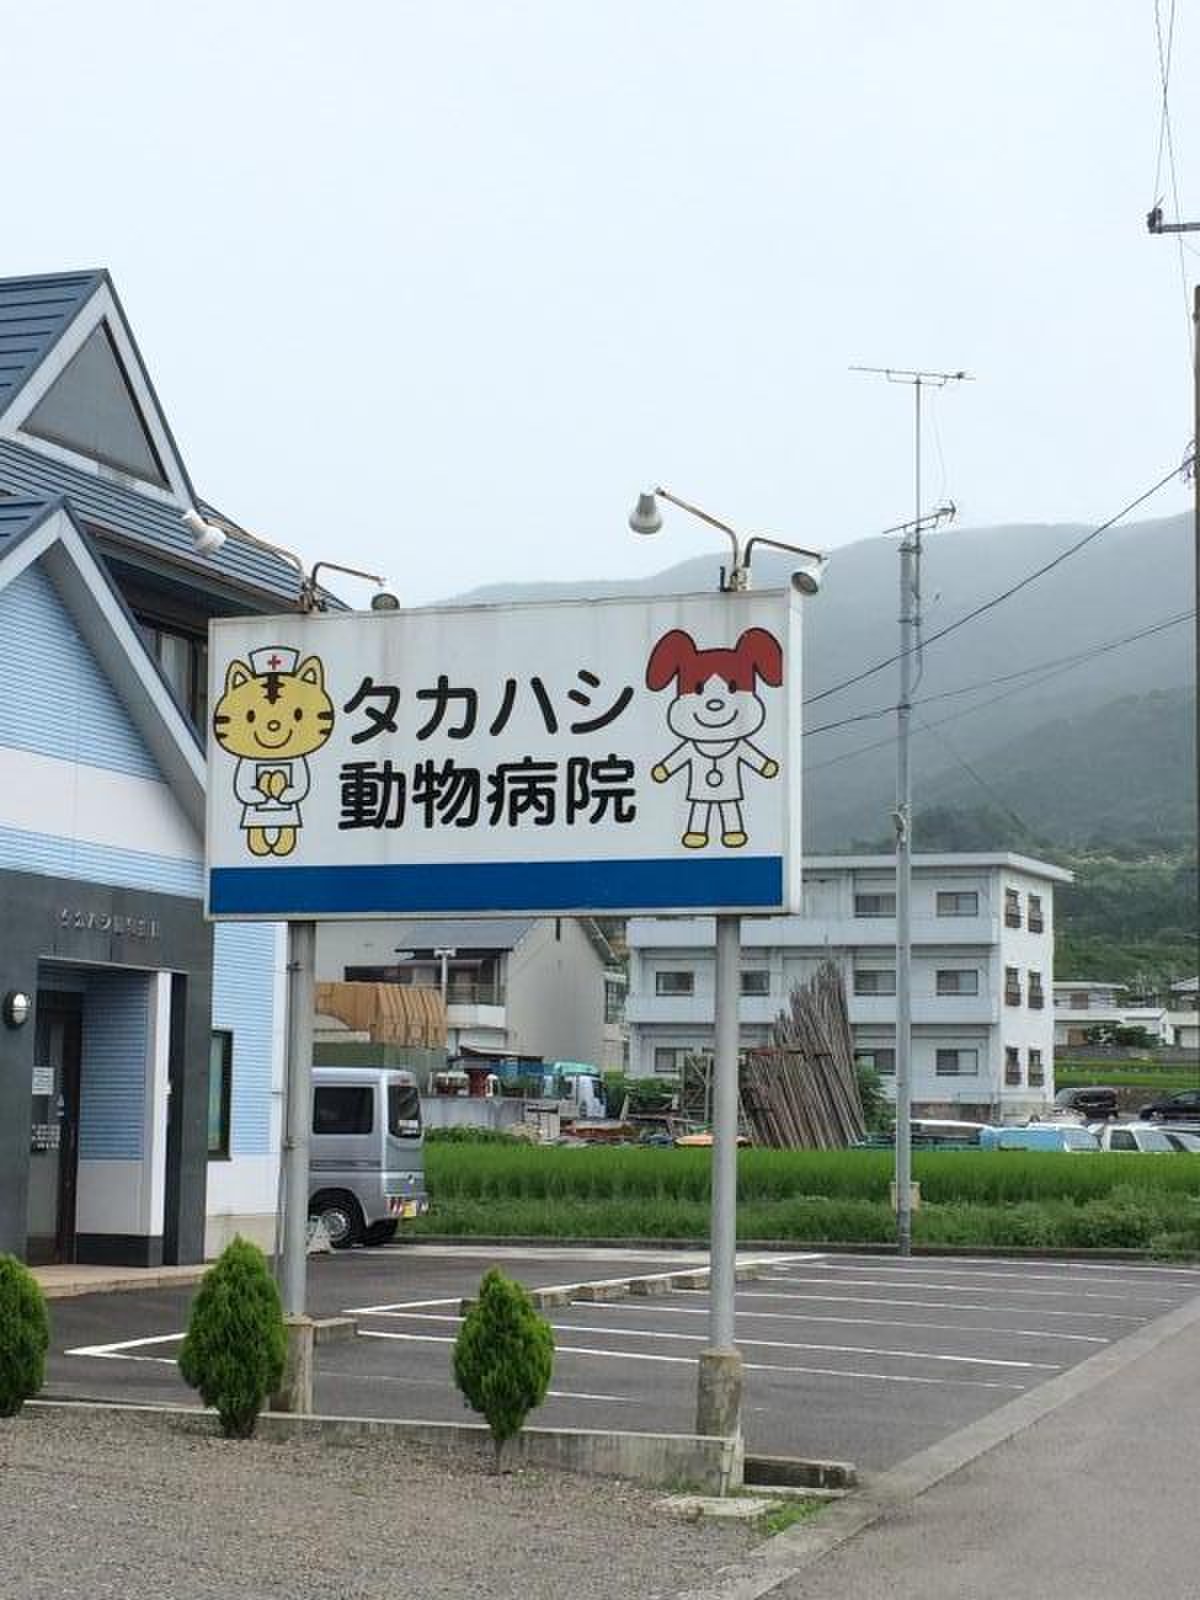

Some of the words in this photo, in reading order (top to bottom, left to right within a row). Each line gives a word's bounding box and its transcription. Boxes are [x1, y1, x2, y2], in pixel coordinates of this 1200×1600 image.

[343, 669, 635, 745] タカハシ
[337, 753, 637, 831] 動物病院
